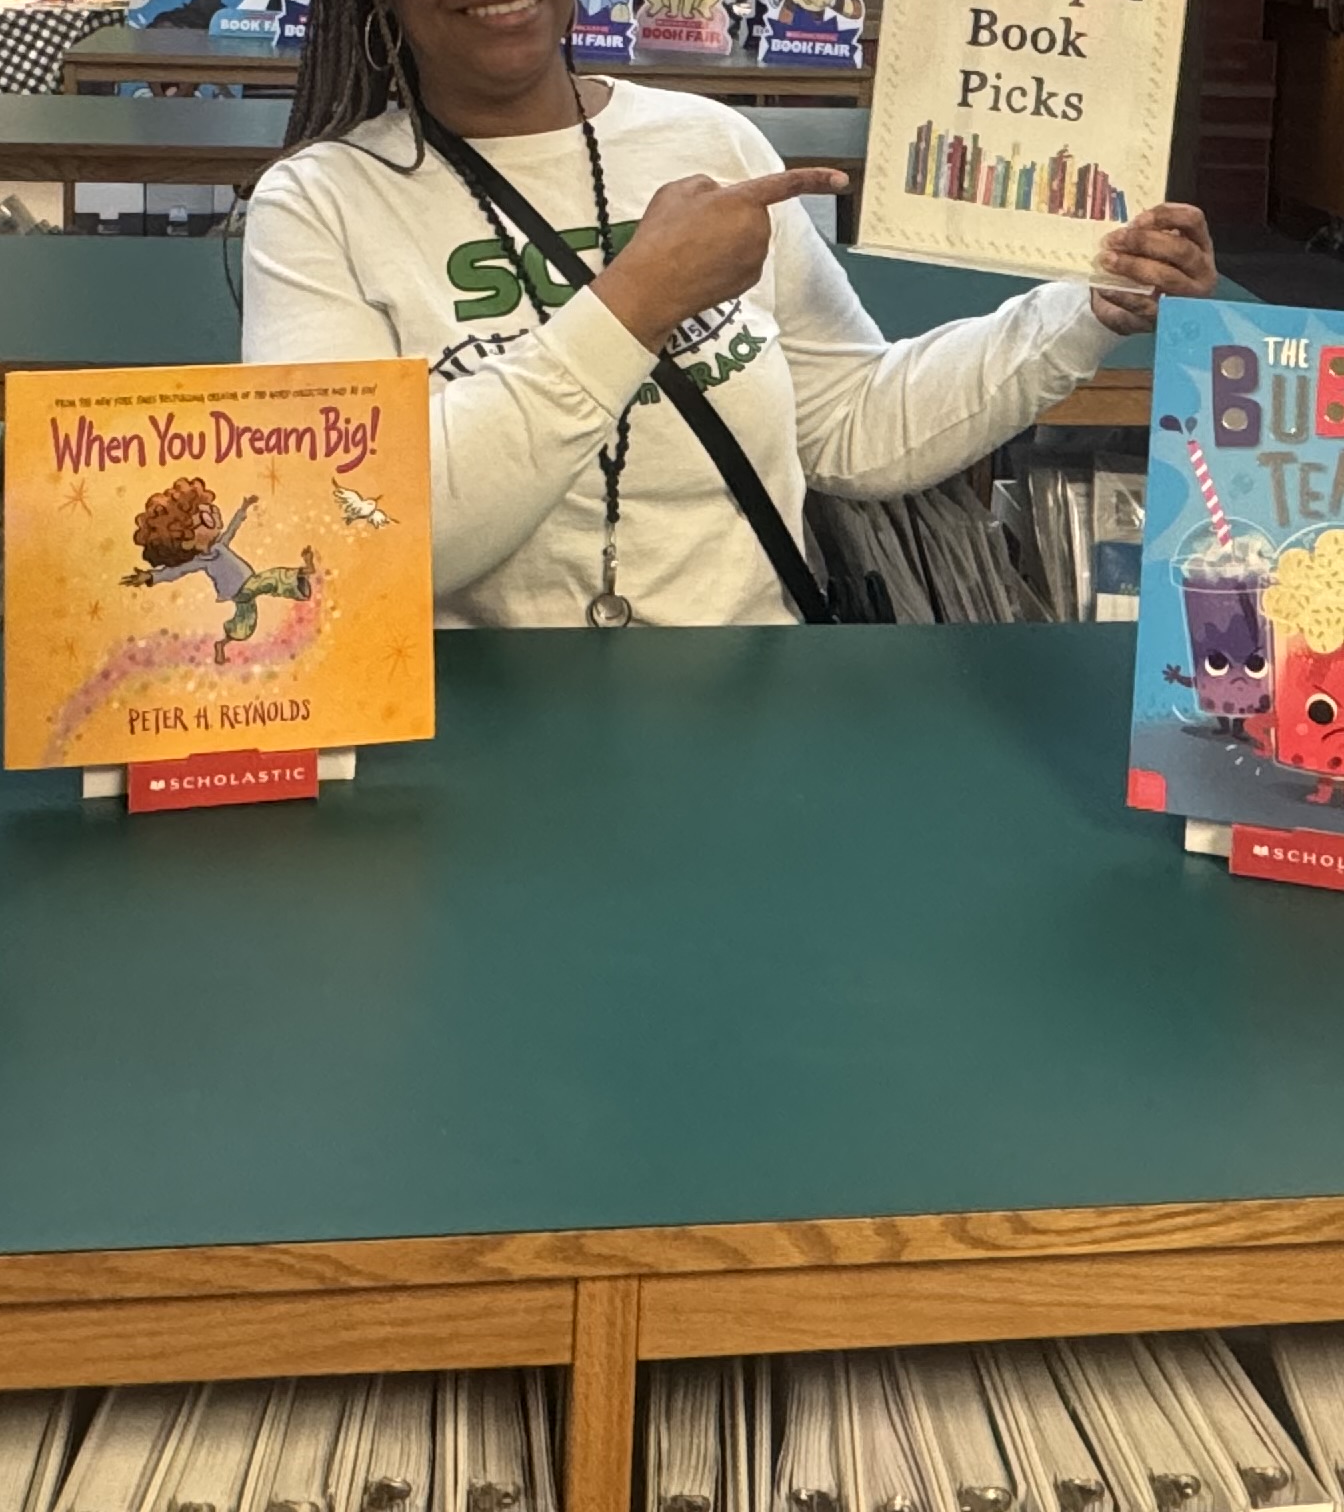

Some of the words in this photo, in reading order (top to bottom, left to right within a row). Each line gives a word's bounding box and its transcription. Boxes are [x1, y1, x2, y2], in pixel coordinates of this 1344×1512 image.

[220, 19, 260, 31] BOOK
[264, 20, 280, 31] FA
[642, 27, 684, 42] BOOK
[686, 29, 722, 44] FAIR
[966, 7, 1088, 59] Book
[585, 35, 624, 48] FAIR
[771, 39, 813, 54] BOOK
[814, 42, 851, 57] FAIR
[957, 69, 1084, 121] Picks
[686, 324, 767, 393] RACK
[1263, 337, 1310, 368] THE
[51, 414, 146, 474] When
[148, 412, 206, 467] You
[209, 410, 317, 463] Dream
[319, 405, 381, 474] Big!
[128, 706, 188, 735] PETER
[194, 705, 213, 730] H.
[220, 699, 311, 729] REYNOLDS
[169, 766, 306, 791] SCHOLASTIC
